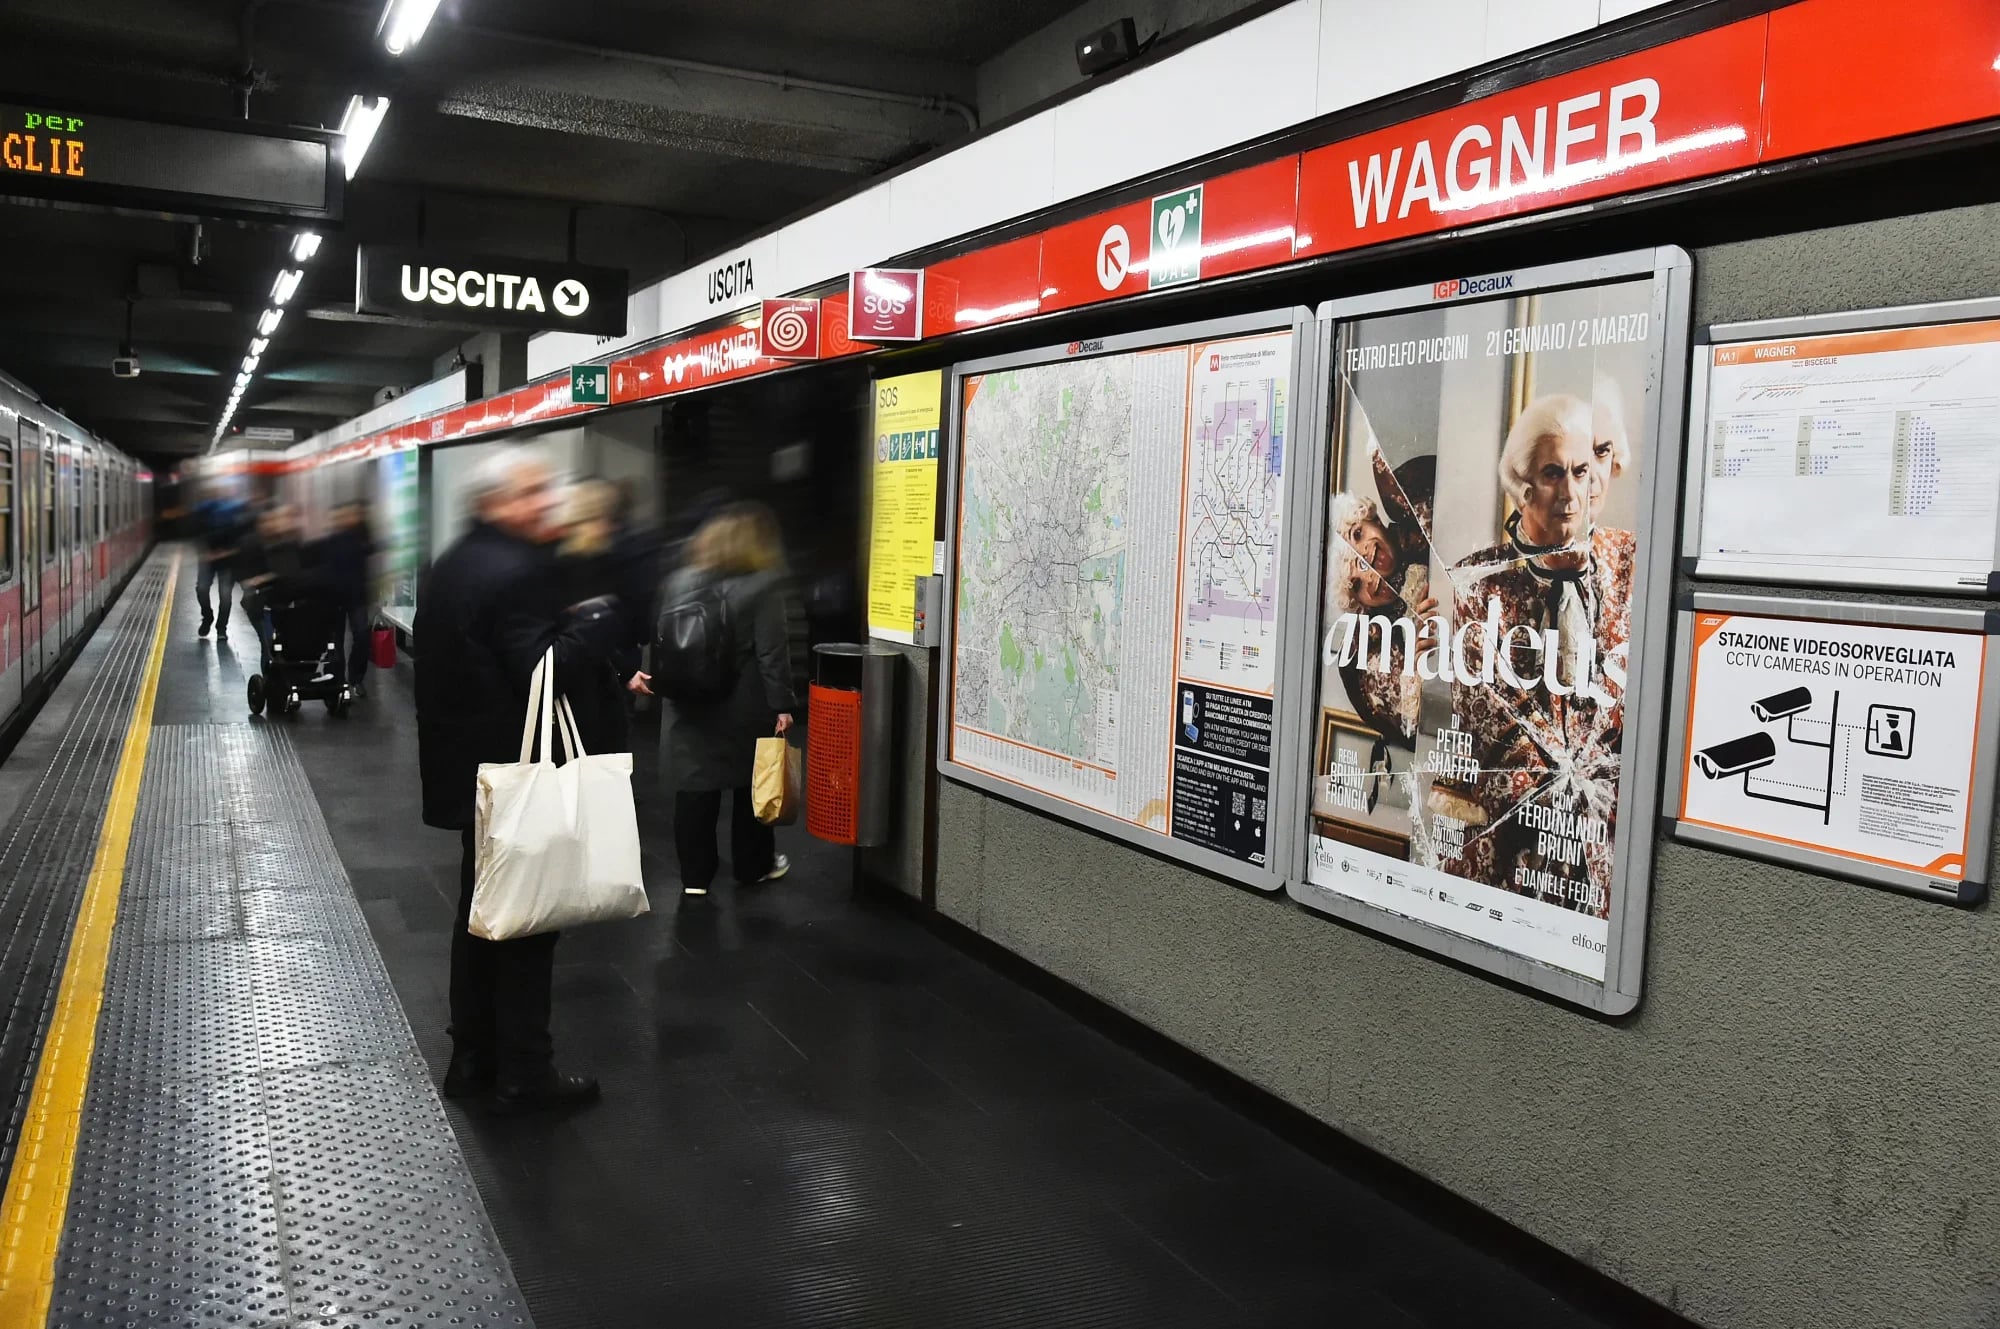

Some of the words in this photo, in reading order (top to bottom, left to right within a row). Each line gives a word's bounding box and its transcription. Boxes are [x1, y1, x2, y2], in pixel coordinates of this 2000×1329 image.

[25, 112, 84, 132] per
[3, 132, 84, 176] GLIE
[1346, 77, 1661, 229] WAGNER
[401, 264, 546, 313] USCITA
[708, 257, 754, 304] USCITA
[1433, 275, 1513, 299] IGPDecaux
[863, 295, 906, 315] SOS
[700, 331, 758, 378] WAGNER
[1346, 343, 1386, 372] TEATRO
[1389, 340, 1415, 368] ELFO
[1418, 334, 1469, 364] PUCCINI
[1486, 330, 1500, 357] 21
[1503, 322, 1566, 355] GENNAIO
[1578, 319, 1589, 348] 2
[1591, 312, 1649, 345] MARZO
[1754, 345, 1797, 359] WAGNER
[1804, 357, 1838, 367] BISCEGLIE
[880, 386, 898, 408] SOS
[1322, 597, 1629, 708] amadeus
[1718, 631, 1790, 653] STAZIONE
[1793, 637, 1956, 669] VIDEOSORVEGLIATA
[1726, 651, 1761, 668] CCTV
[1763, 654, 1831, 676] CAMERAS
[1834, 661, 1849, 678] IN
[1853, 664, 1942, 688] OPERATION
[1451, 713, 1460, 730] DI
[1338, 748, 1358, 766] REGIA
[1436, 728, 1473, 757] PETER
[1427, 750, 1480, 784] SHAFFER
[1325, 782, 1370, 813] FRONGIA
[1552, 790, 1574, 812] CON
[1432, 825, 1464, 846] ANTONIO
[1518, 801, 1608, 845] FERDINANDO
[1320, 851, 1334, 864] elfo
[1538, 831, 1582, 866] BRUNI
[1514, 868, 1521, 885] E
[1522, 868, 1566, 898] DANIELE
[1572, 932, 1607, 954] elfo.or
